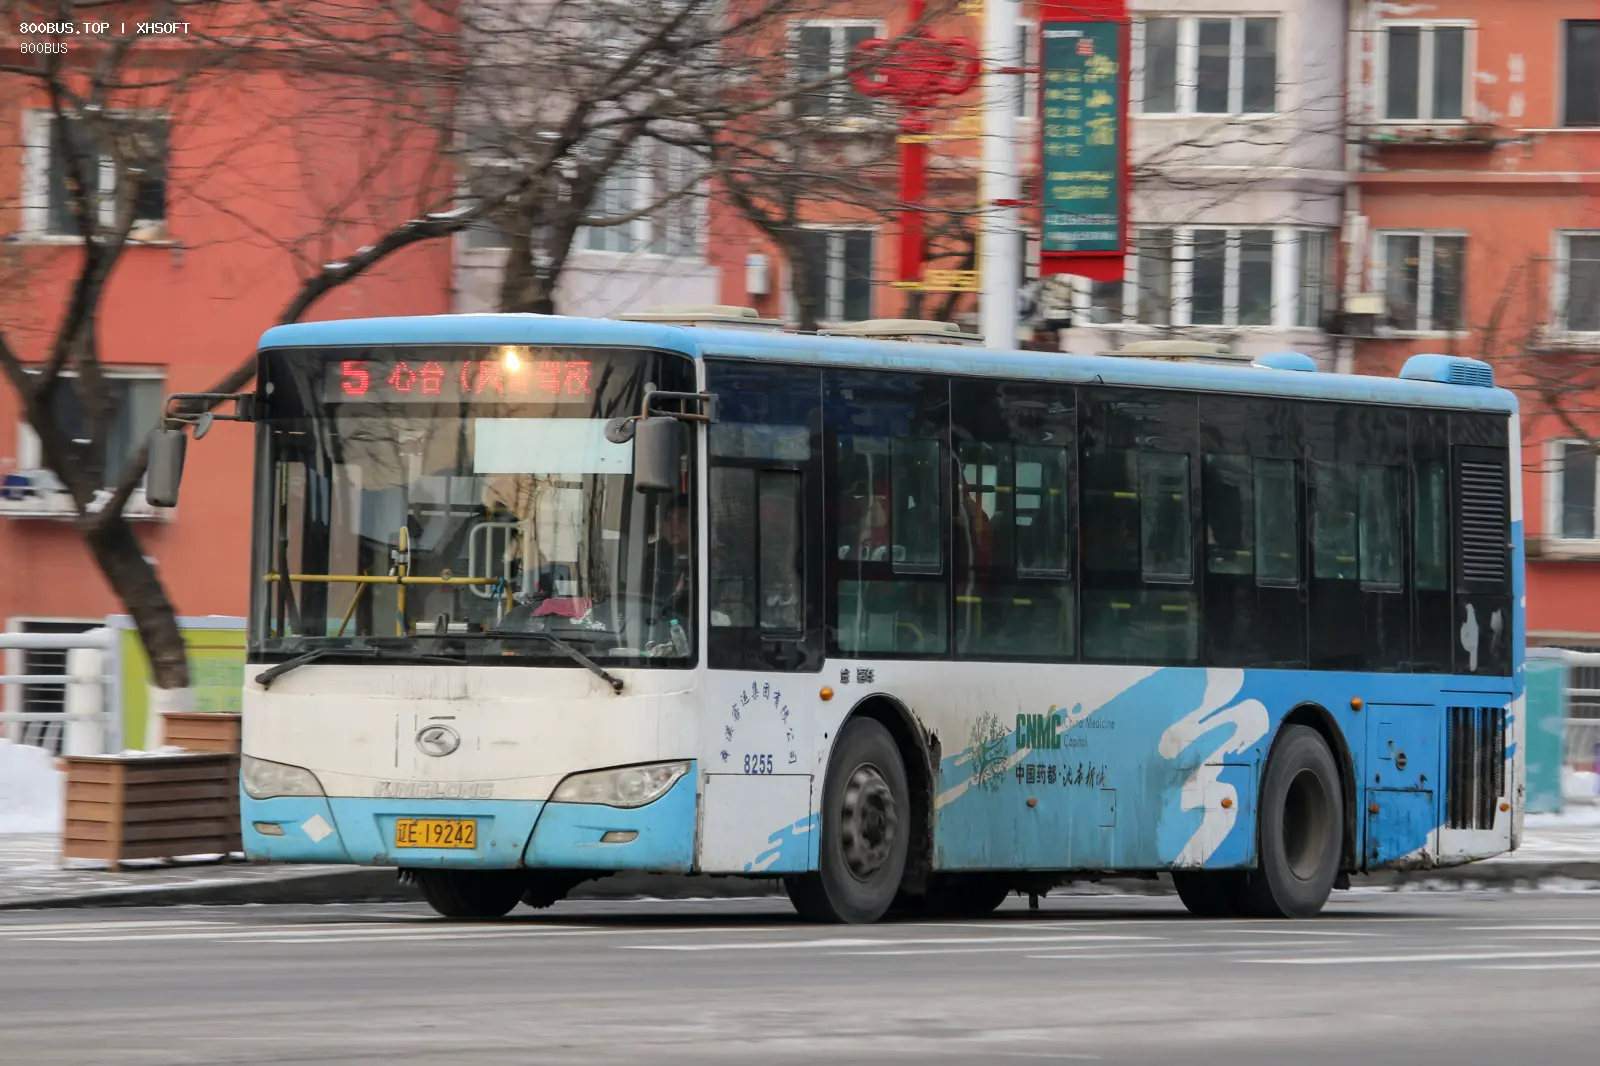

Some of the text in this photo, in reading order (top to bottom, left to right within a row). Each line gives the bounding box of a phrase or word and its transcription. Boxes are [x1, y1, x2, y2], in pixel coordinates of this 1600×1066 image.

[341, 361, 370, 395] 5
[1015, 713, 1062, 750] CNMC
[744, 754, 773, 775] 8255
